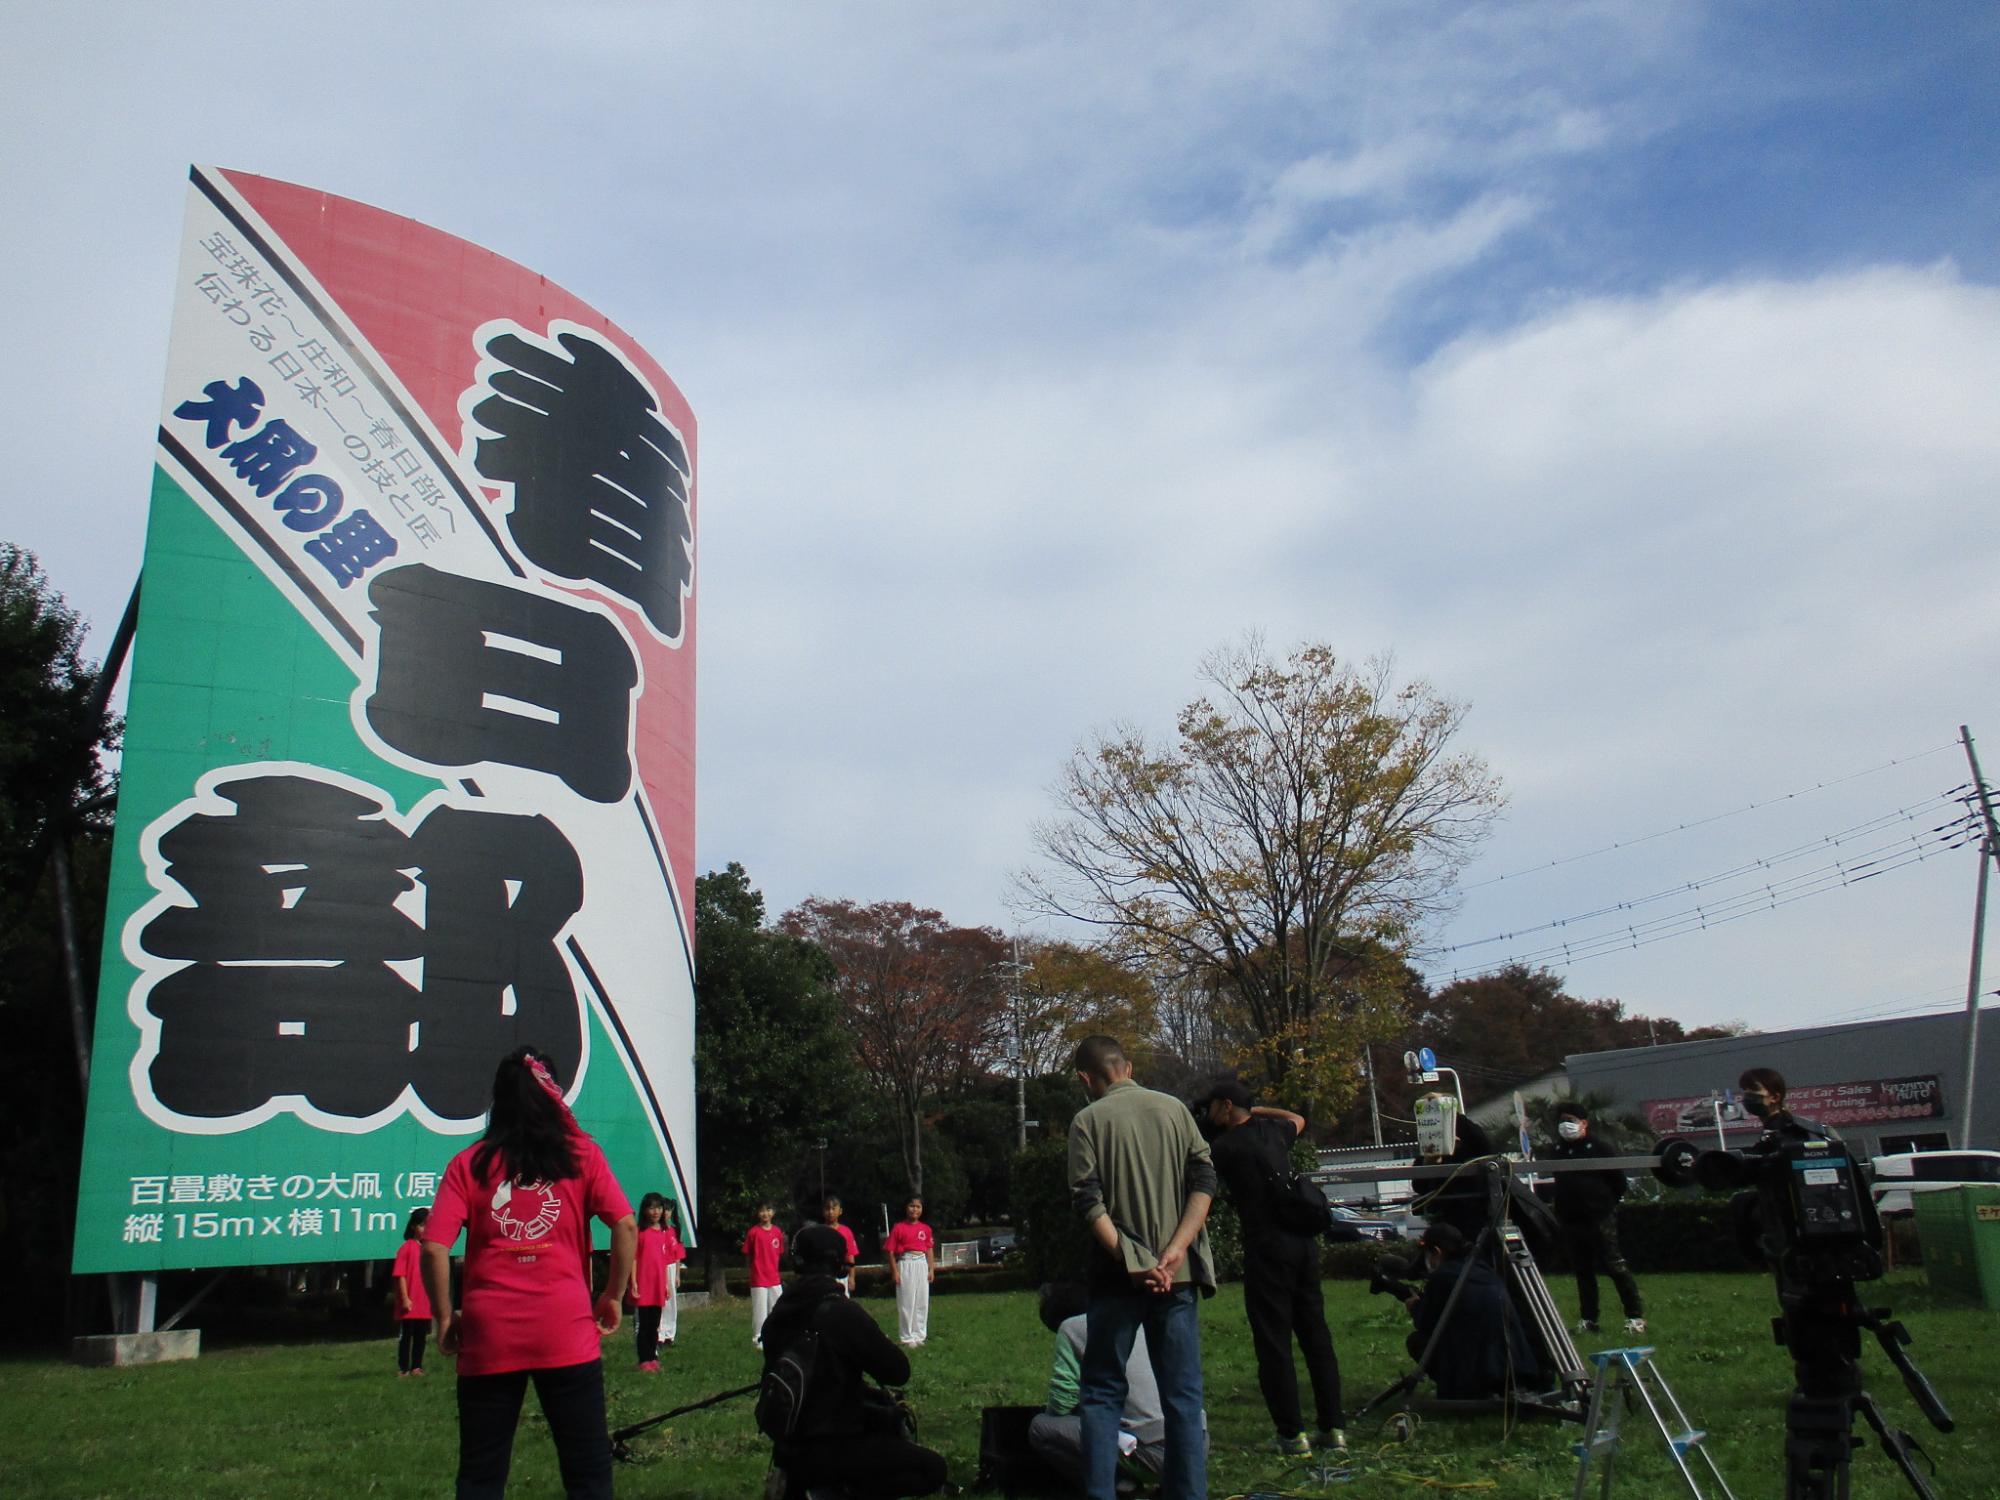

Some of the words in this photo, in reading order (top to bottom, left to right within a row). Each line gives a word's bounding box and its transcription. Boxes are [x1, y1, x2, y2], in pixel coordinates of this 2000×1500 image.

[194, 272, 441, 549] 伝わる日本一の技と匠
[128, 324, 696, 1129] 春日部
[1812, 1088, 1834, 1098] Car
[1837, 1085, 1873, 1095] Sales
[1896, 1088, 1930, 1101] AUTO
